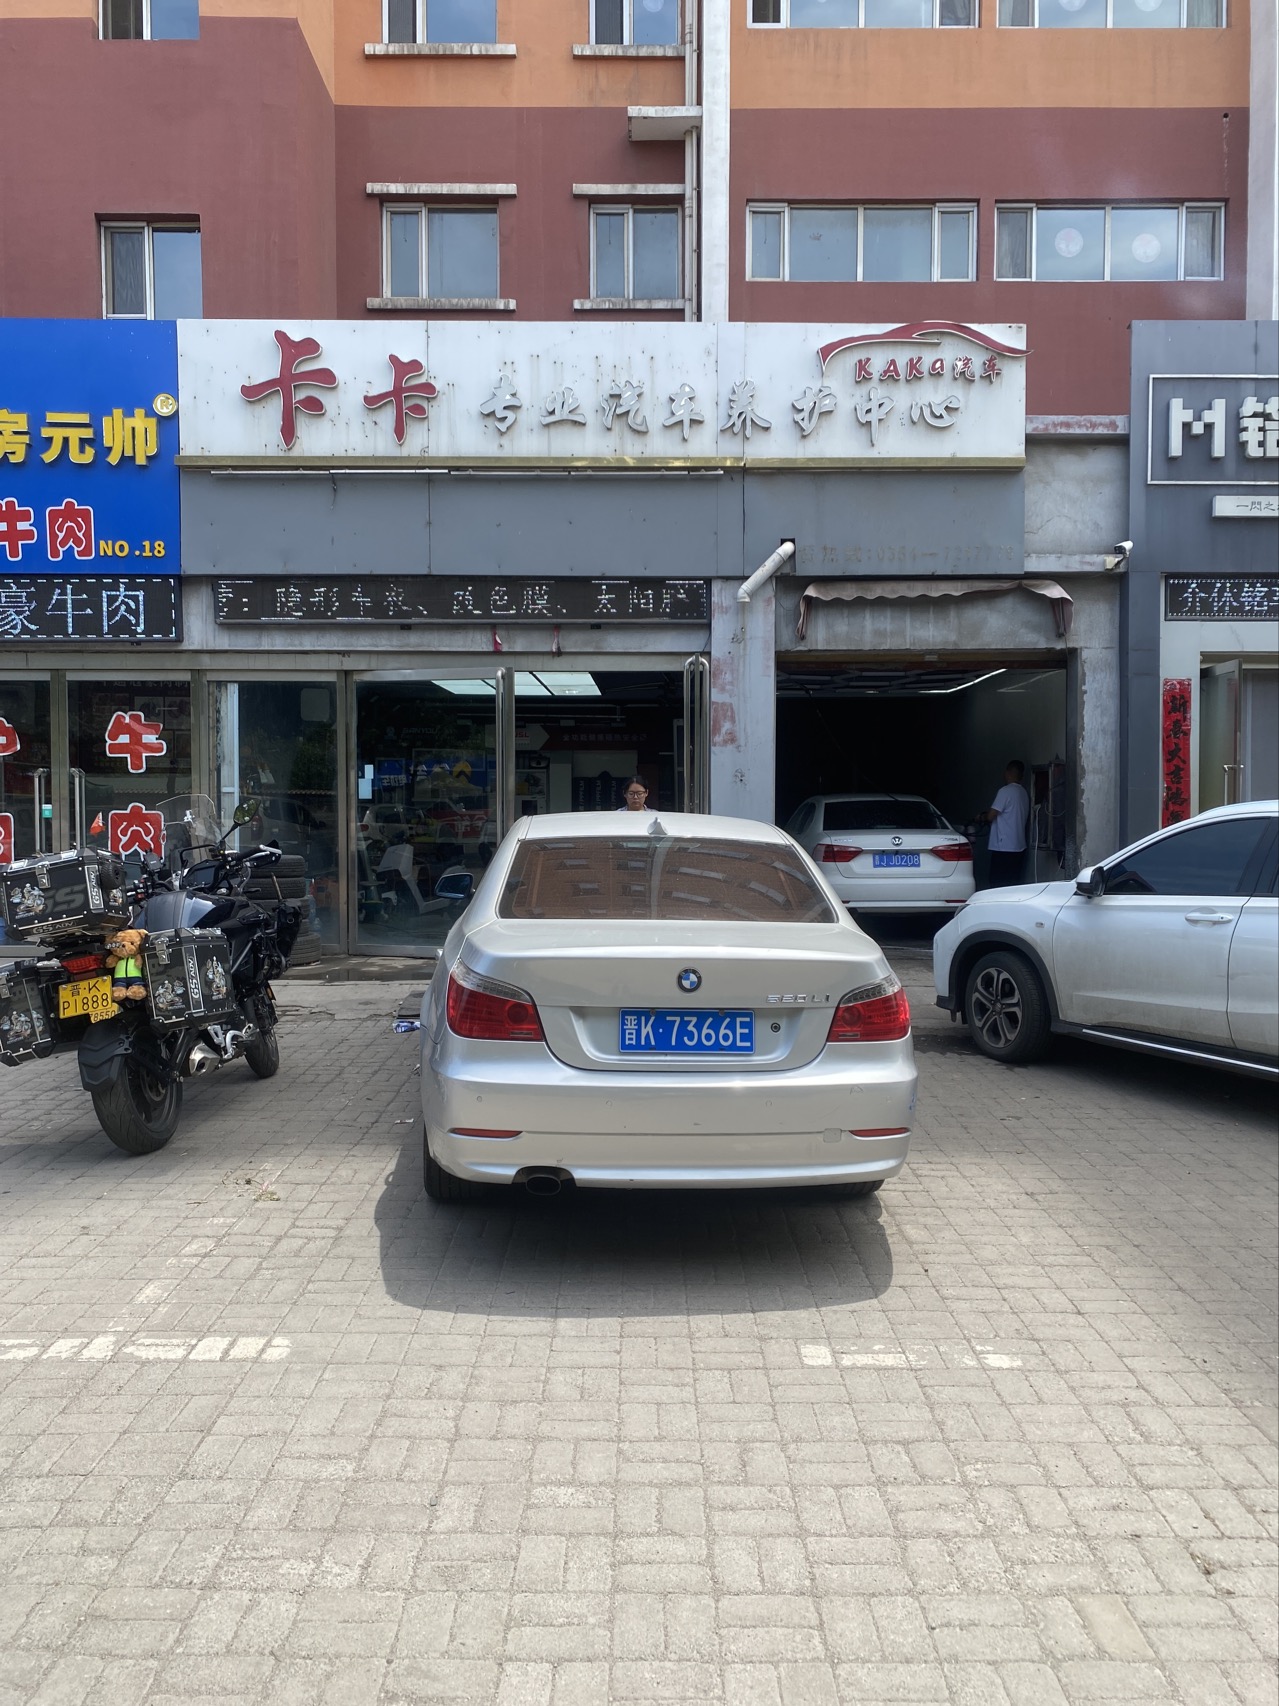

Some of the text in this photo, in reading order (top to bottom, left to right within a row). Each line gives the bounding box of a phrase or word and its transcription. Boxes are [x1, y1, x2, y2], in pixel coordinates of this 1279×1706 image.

[240, 329, 962, 450] 卡卡 专业汽车养护中心
[0, 407, 158, 466] 房元帅
[0, 497, 95, 562] 牛肉
[1236, 500, 1279, 513] 一閃之
[0, 583, 145, 635] 豪牛肉
[62, 992, 110, 1017] P1888
